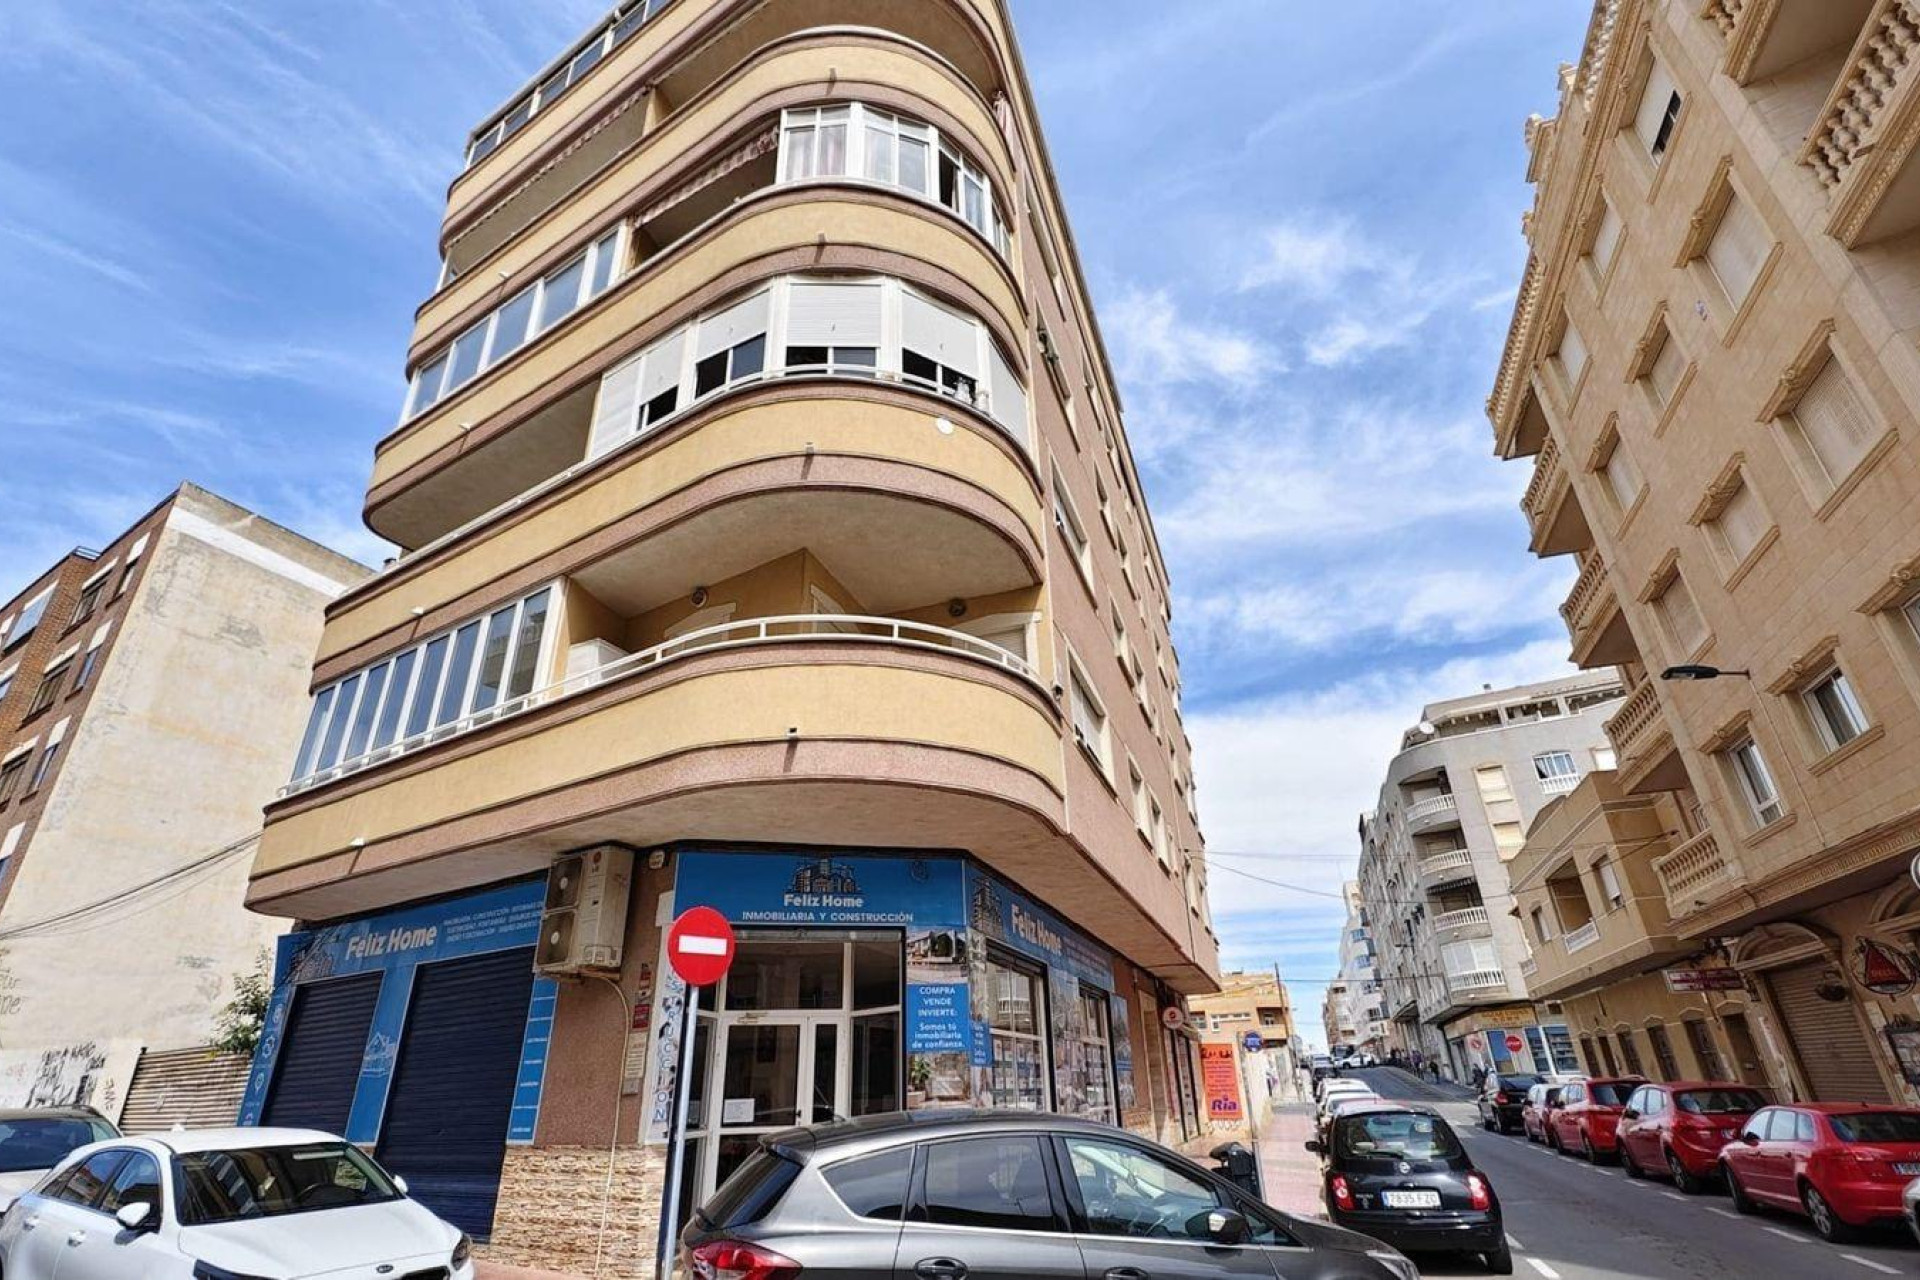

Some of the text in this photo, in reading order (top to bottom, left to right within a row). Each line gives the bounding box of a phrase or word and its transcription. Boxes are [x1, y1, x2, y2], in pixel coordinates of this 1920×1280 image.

[783, 893, 864, 907] Feliz Home
[742, 911, 913, 922] INMOBILIARIA Y CONSTRUCCIÓN
[1011, 903, 1062, 956] Feliz Home
[345, 932, 387, 961] Feliz
[387, 926, 438, 952] Home
[919, 986, 955, 995] COMPRA
[920, 1022, 946, 1031] Somos
[914, 1031, 962, 1039] inmobiliaria
[911, 1040, 923, 1049] de
[1211, 1097, 1237, 1111] Ria
